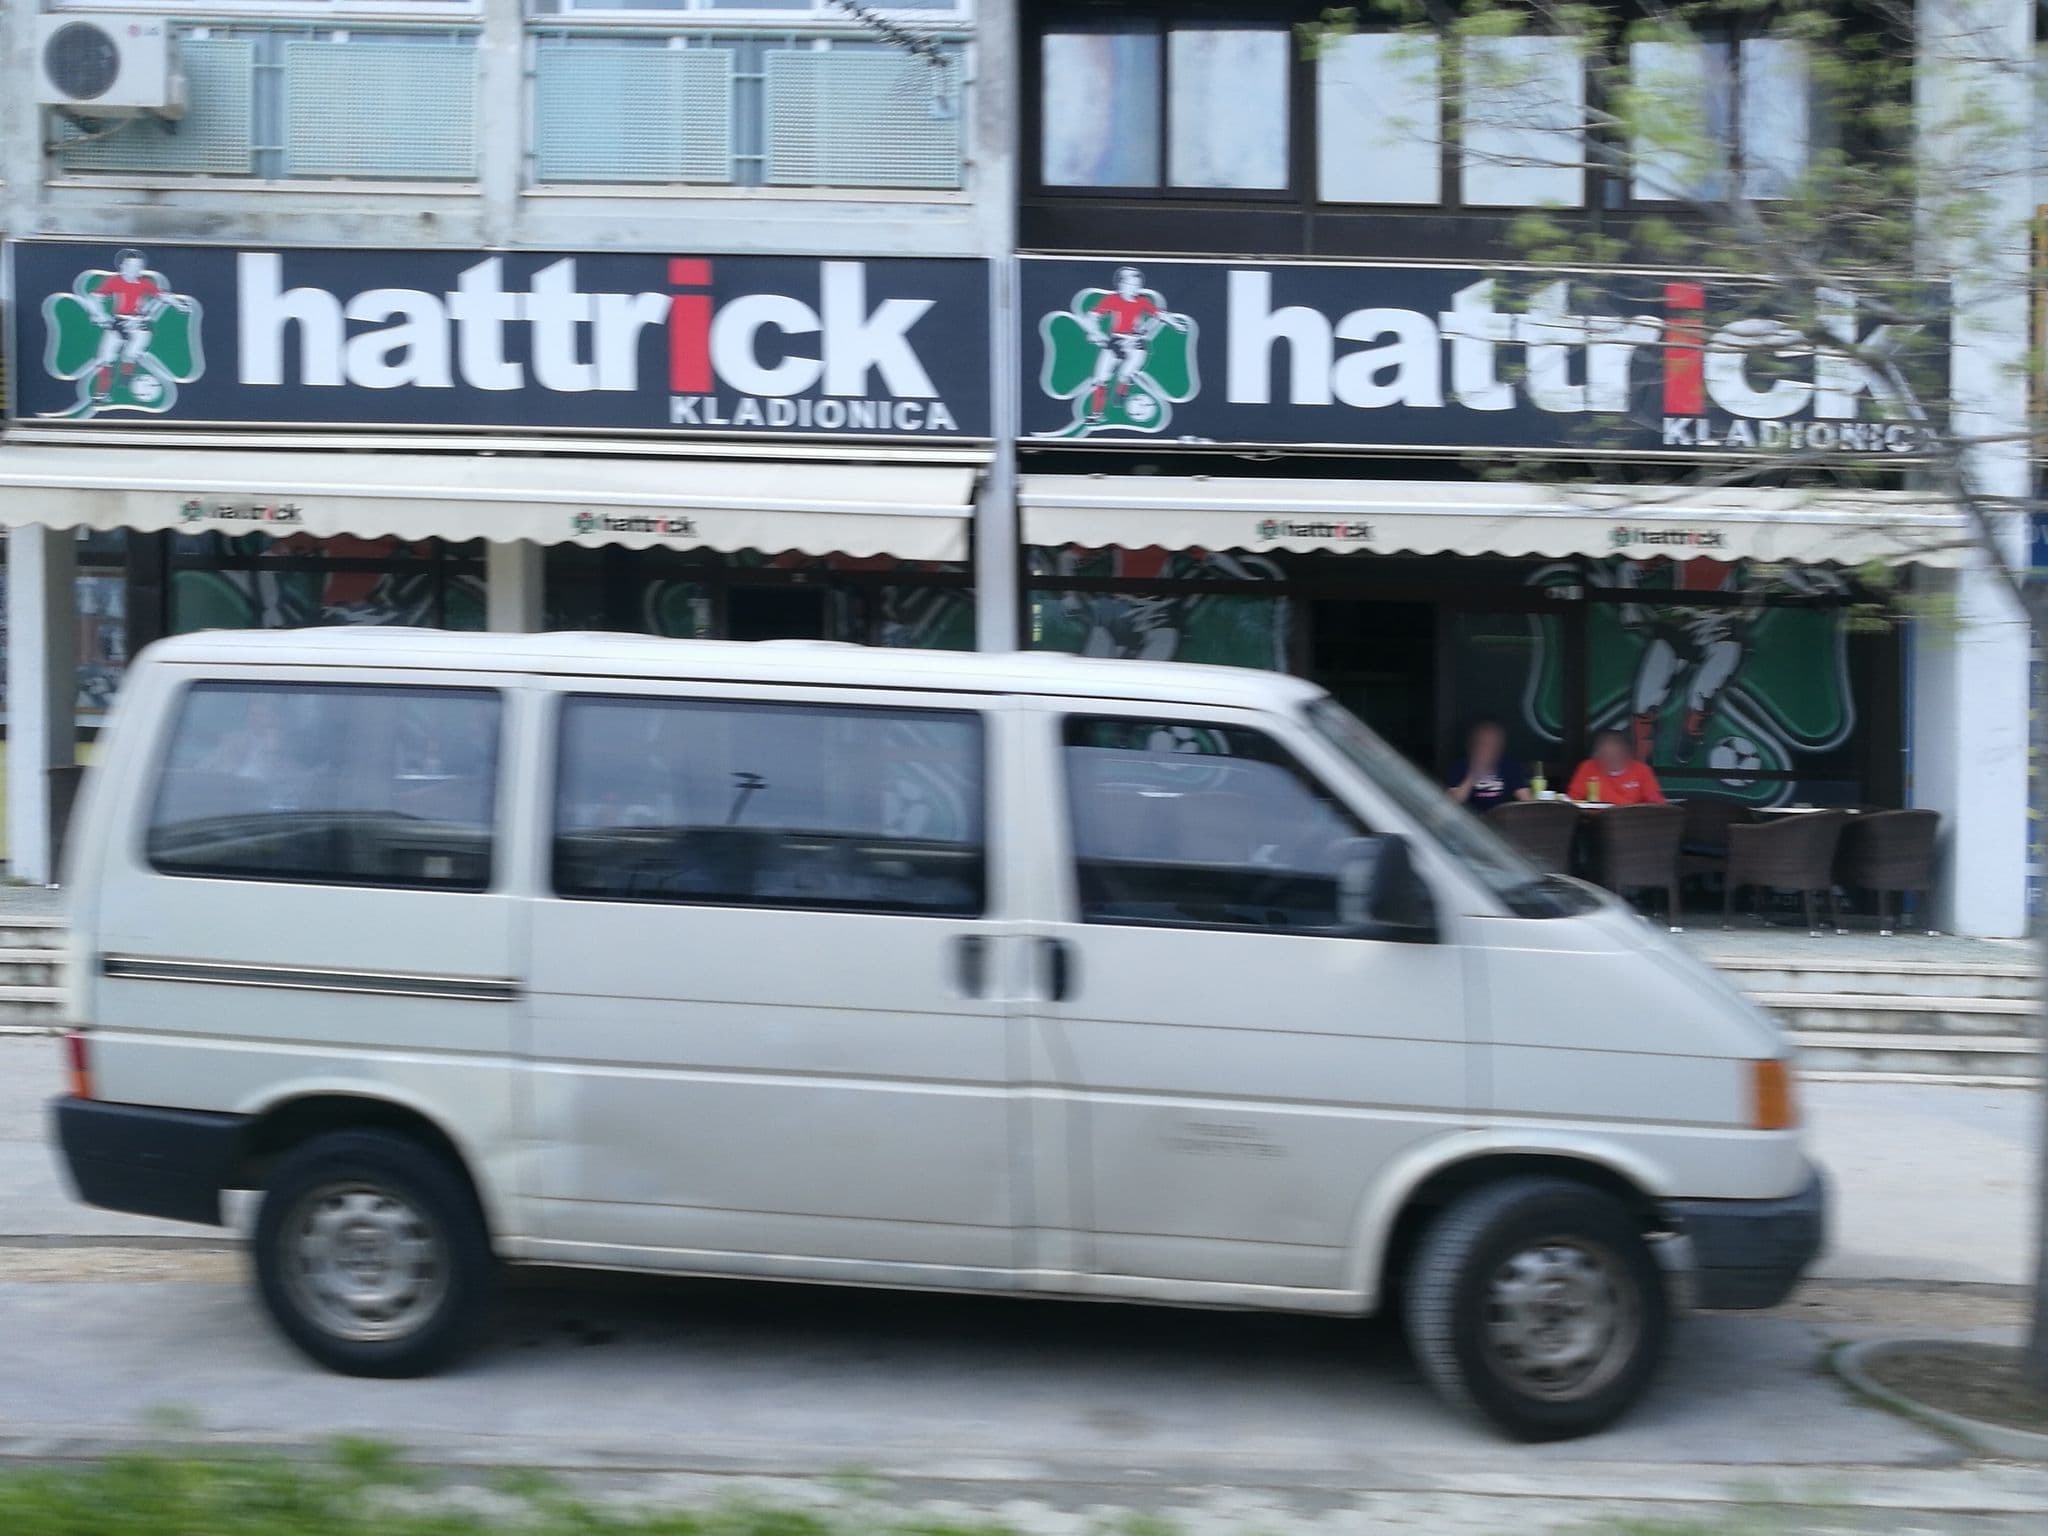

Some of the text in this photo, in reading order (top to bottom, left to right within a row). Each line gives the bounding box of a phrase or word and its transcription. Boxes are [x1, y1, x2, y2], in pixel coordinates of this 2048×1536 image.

[237, 252, 940, 398] hattrick
[1226, 270, 1928, 420] hattrick
[669, 395, 959, 431] KLADIONICA
[600, 514, 697, 534] hattrick
[1281, 520, 1376, 538] hattrick
